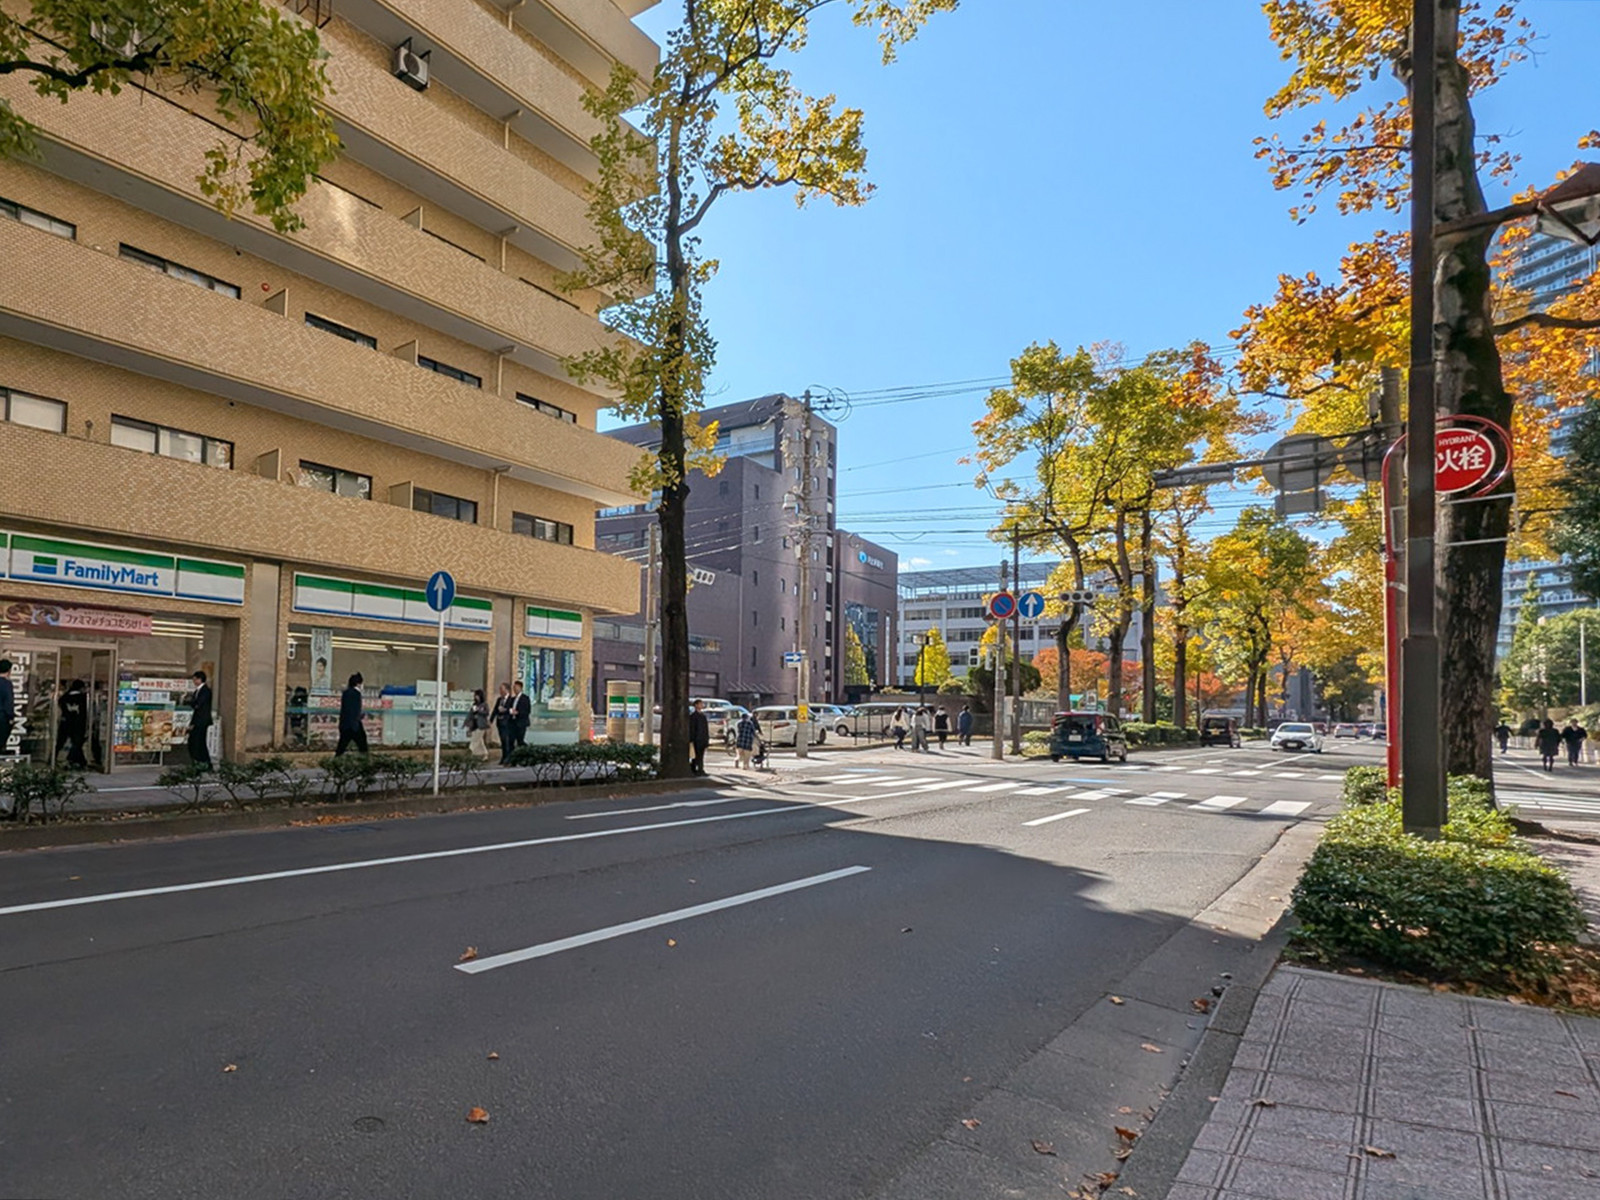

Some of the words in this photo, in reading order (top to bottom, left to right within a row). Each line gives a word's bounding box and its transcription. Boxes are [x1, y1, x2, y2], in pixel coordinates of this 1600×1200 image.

[1438, 435, 1476, 446] HYDRANT
[1434, 445, 1486, 473] 火栓
[63, 560, 159, 586] FamilyMart
